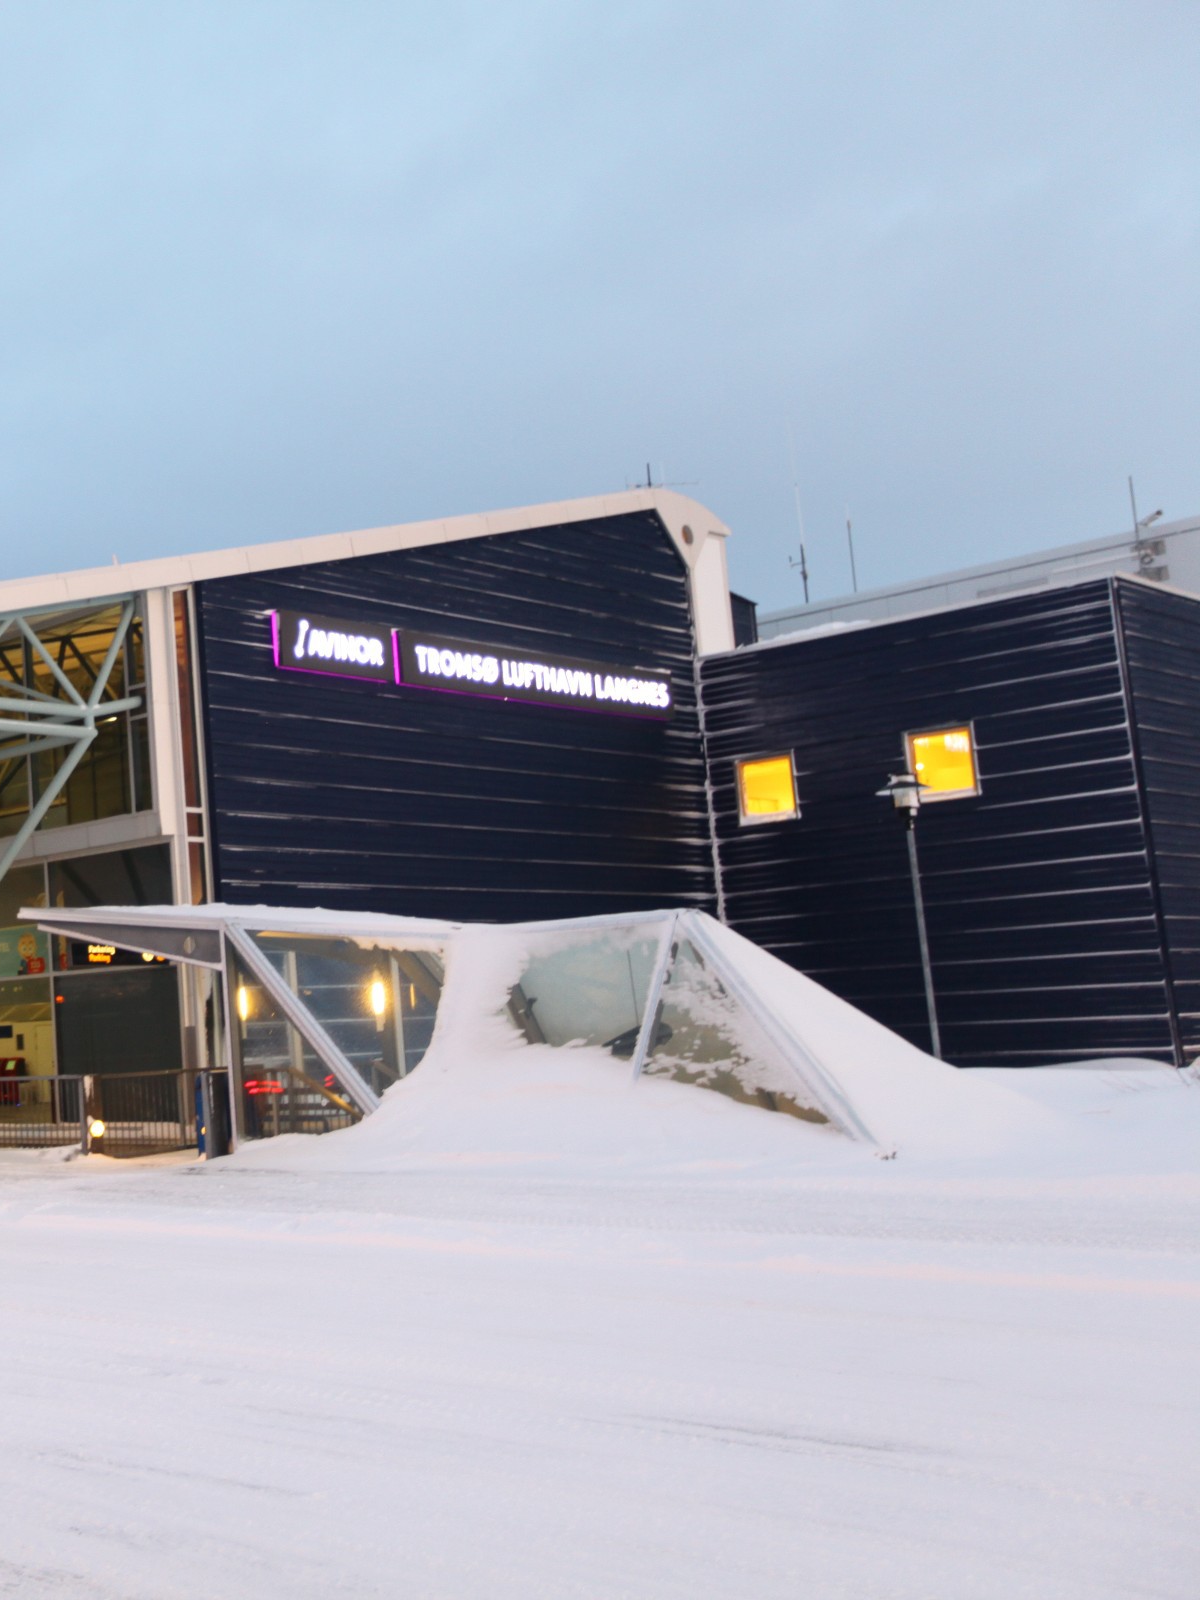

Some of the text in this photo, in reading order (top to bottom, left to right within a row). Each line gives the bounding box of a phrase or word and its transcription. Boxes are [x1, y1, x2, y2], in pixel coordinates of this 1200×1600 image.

[308, 628, 385, 667] AVINOR
[414, 645, 670, 708] TROMSØ LUFTHAVN LANGNES
[88, 944, 116, 956] Parkering
[88, 953, 112, 964] Parking
